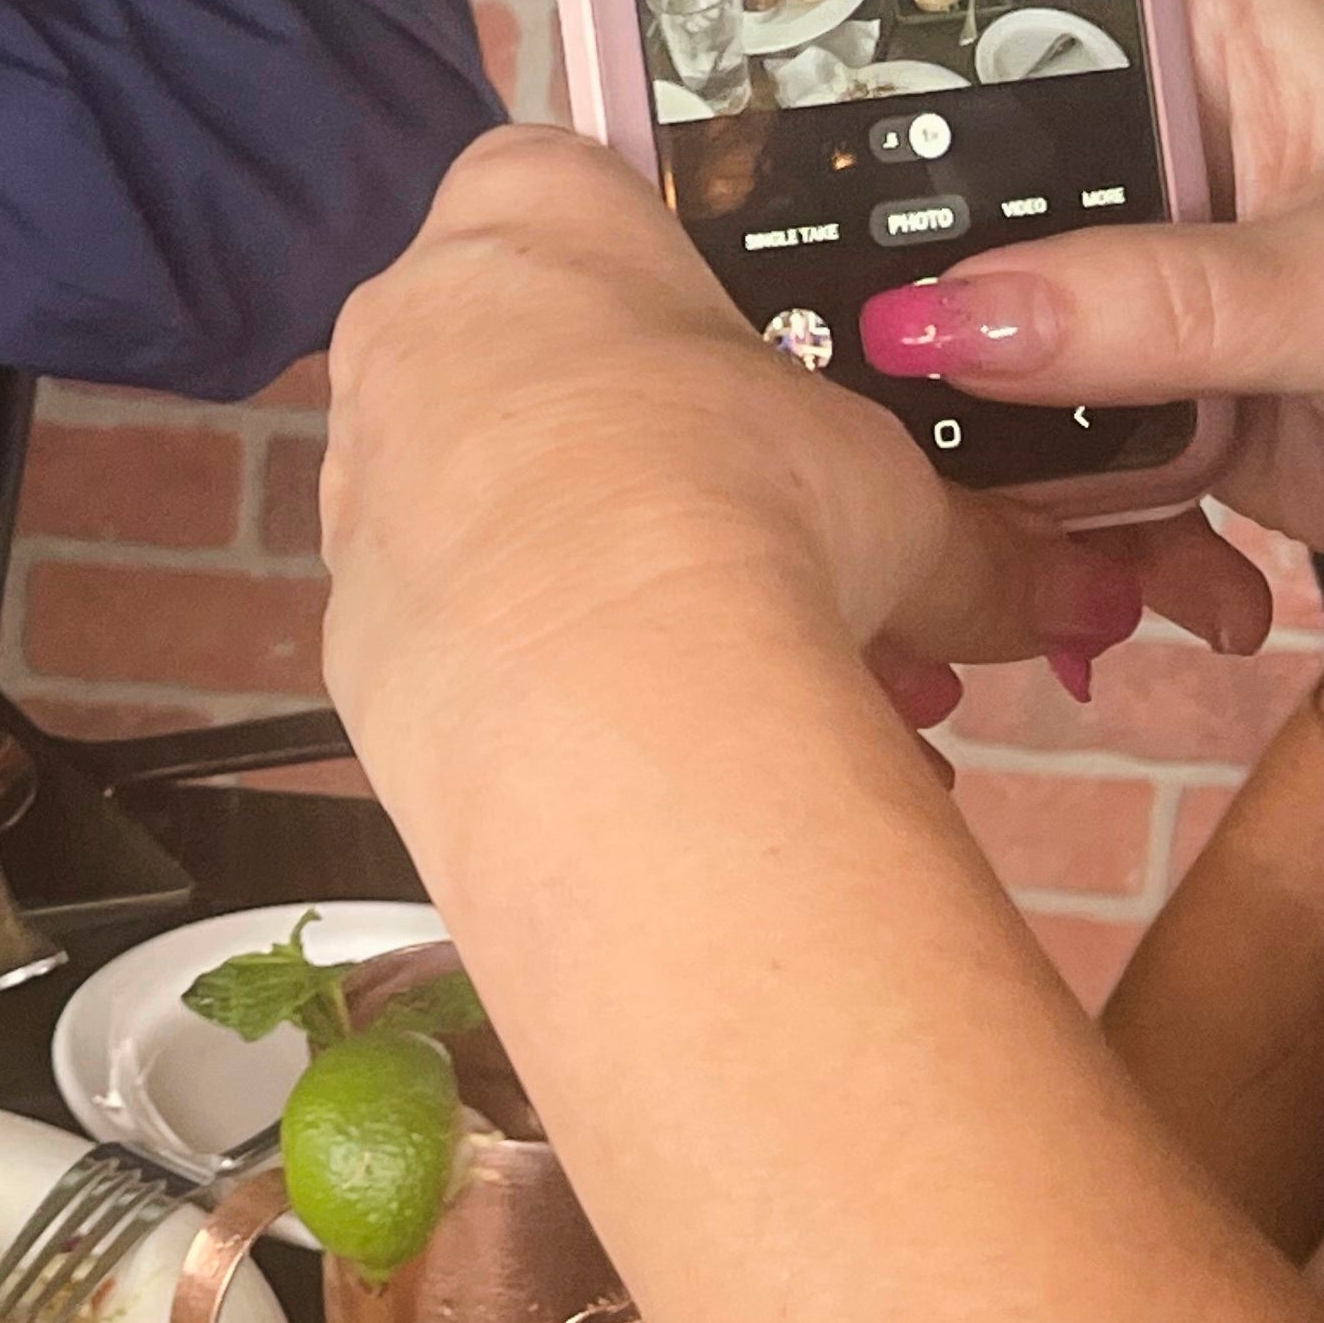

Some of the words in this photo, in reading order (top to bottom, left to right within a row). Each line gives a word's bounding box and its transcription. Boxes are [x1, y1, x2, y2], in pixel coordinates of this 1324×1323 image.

[798, 223, 840, 243] TAKE
[888, 208, 954, 235] PHOTO
[1001, 197, 1047, 217] VIDEO
[1082, 186, 1125, 207] MORE
